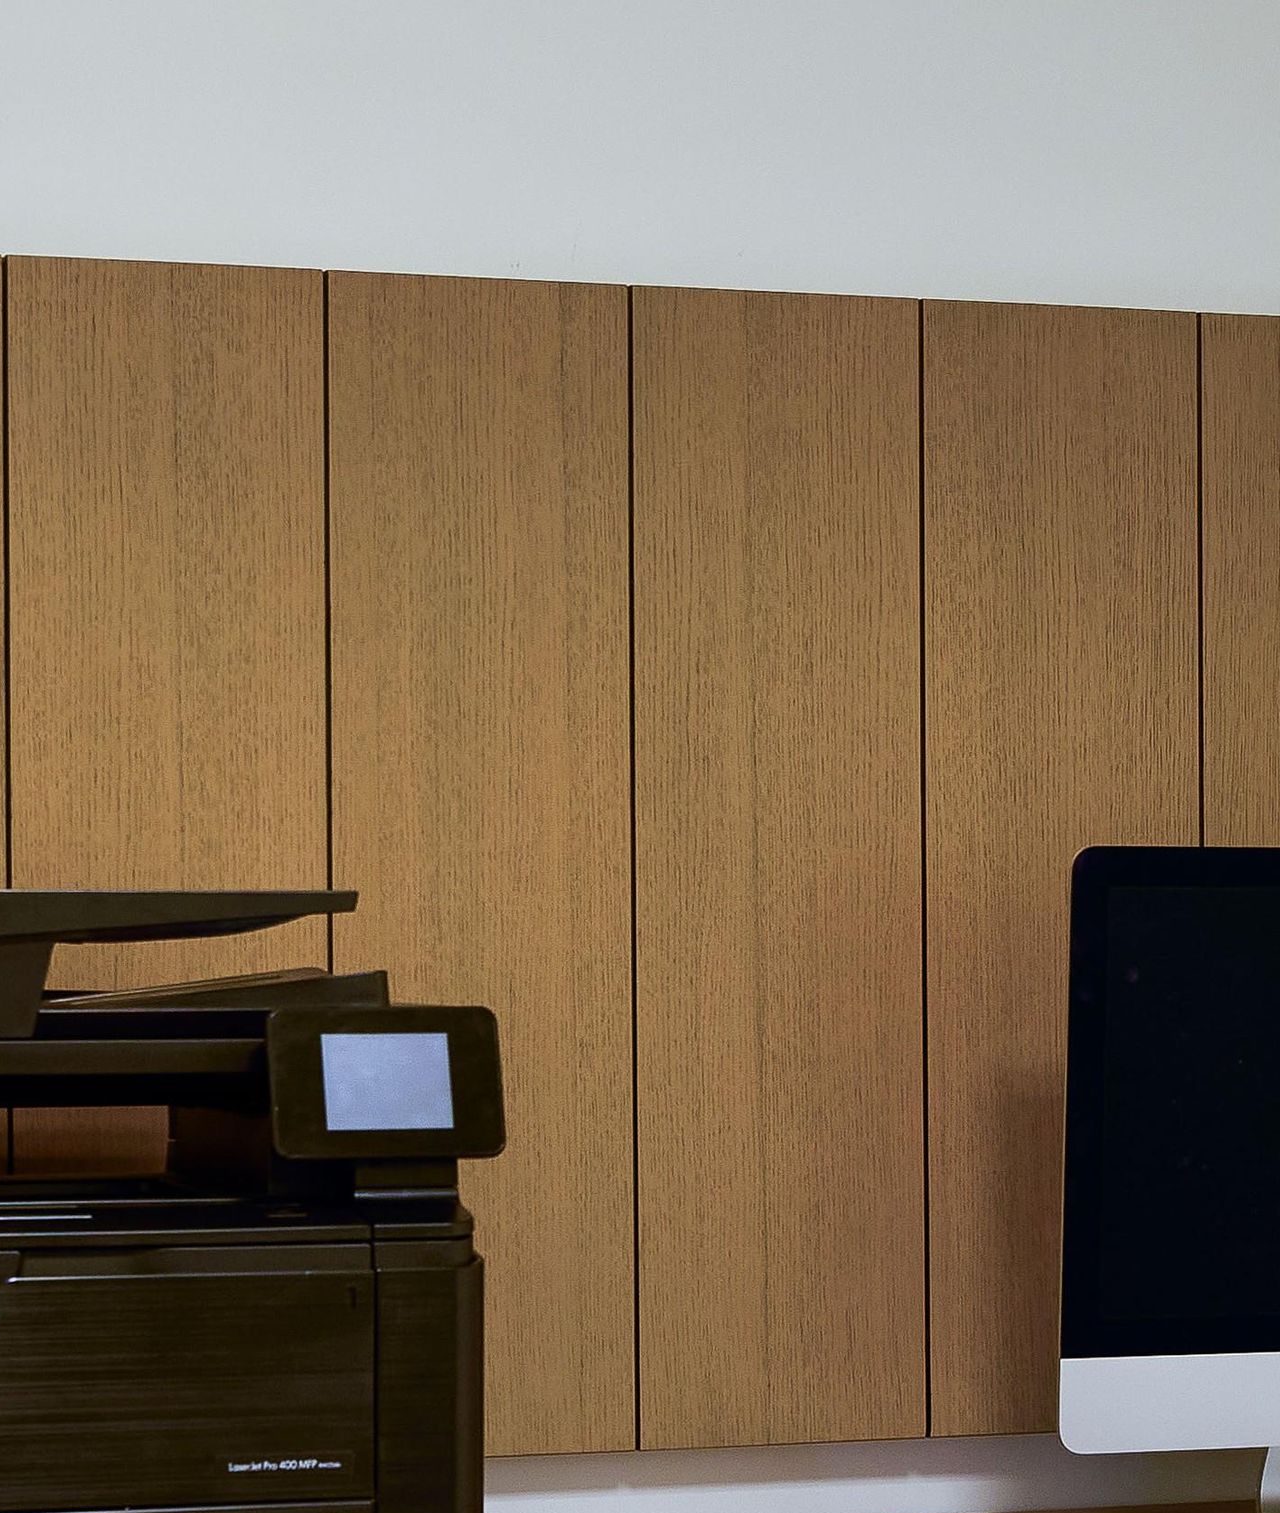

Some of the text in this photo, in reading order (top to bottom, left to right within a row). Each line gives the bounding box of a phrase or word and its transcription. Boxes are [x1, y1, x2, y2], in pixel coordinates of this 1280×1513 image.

[263, 1460, 278, 1471] Pro
[279, 1459, 298, 1471] 400
[298, 1458, 318, 1470] MFP
